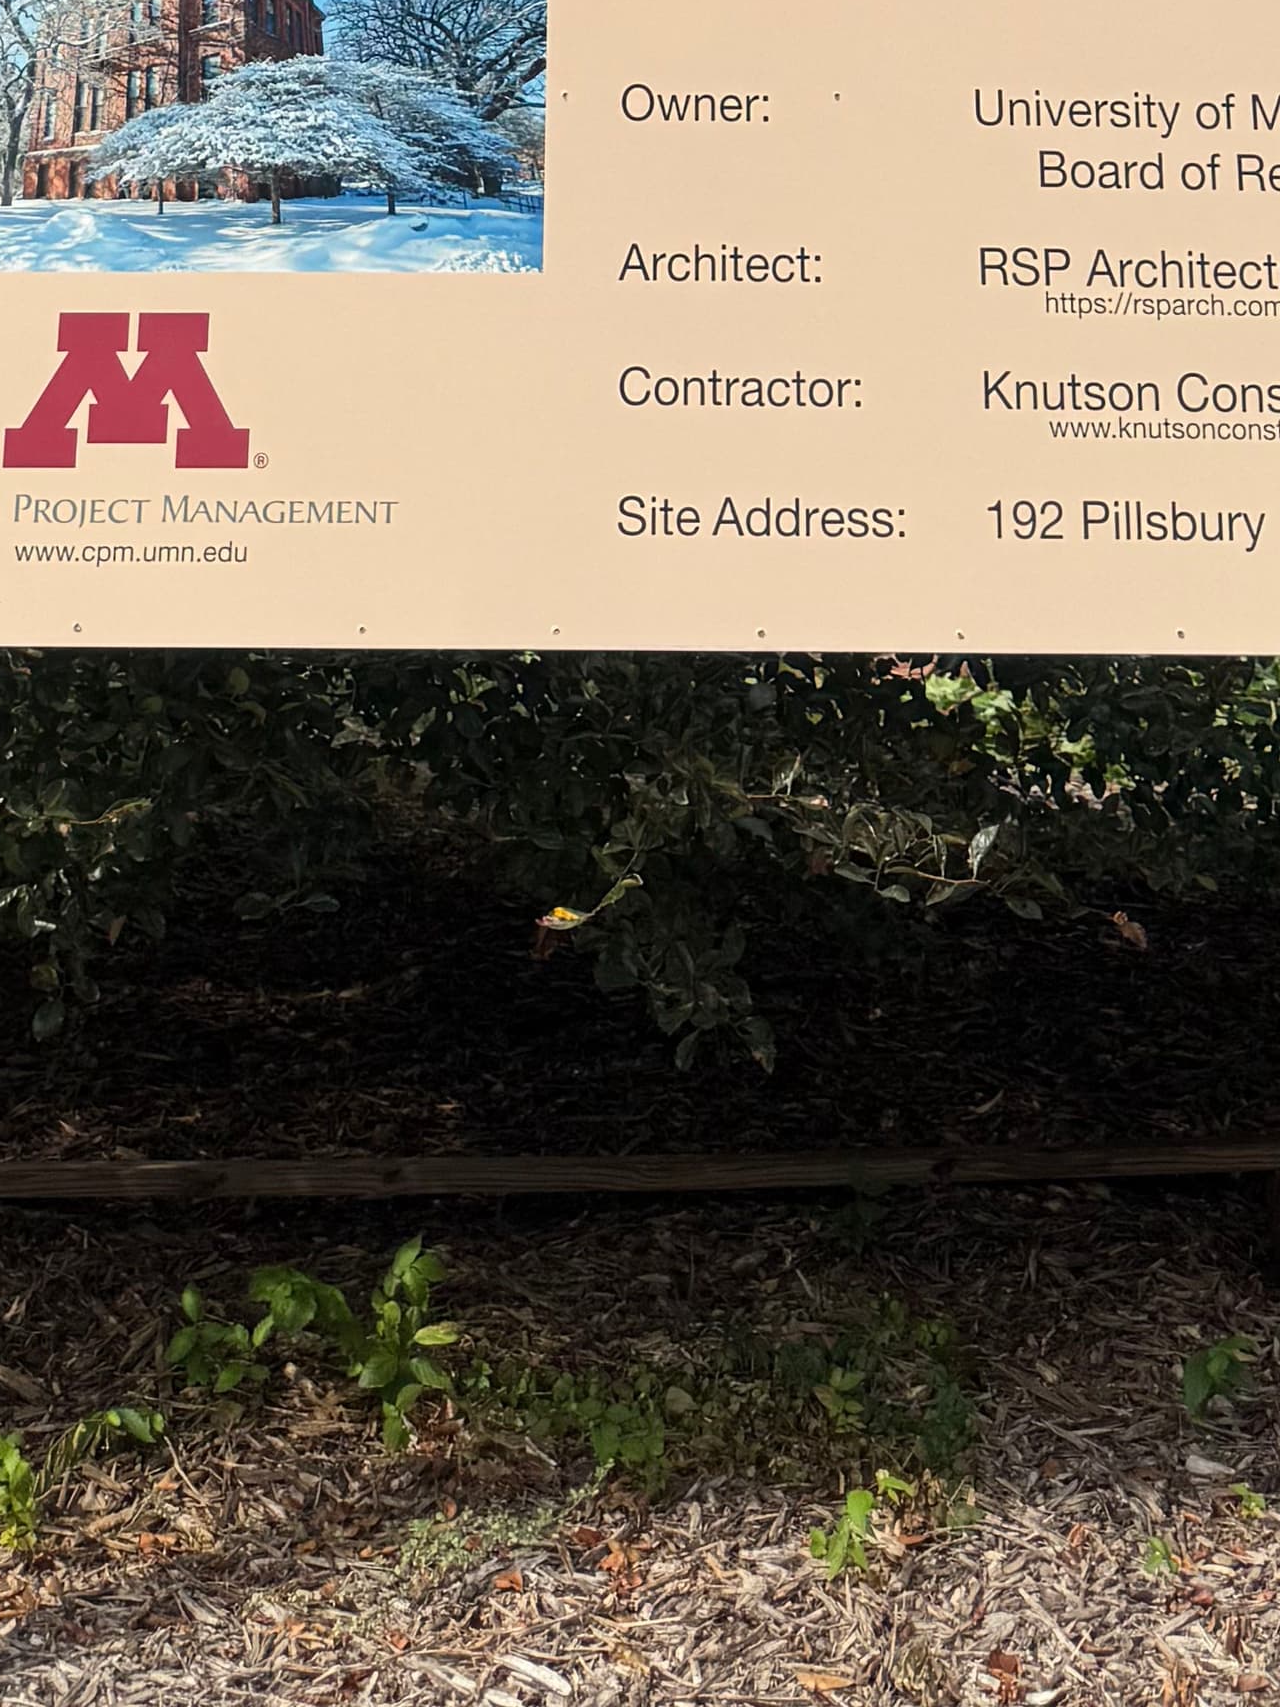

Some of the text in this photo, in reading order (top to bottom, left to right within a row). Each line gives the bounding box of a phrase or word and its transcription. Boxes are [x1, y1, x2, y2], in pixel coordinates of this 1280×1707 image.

[621, 83, 769, 123] Owner:
[974, 88, 1181, 139] University
[1195, 92, 1236, 130] of
[1038, 150, 1165, 190] Board
[1180, 152, 1221, 191] of
[618, 242, 822, 284] Architect:
[979, 246, 1071, 287] RSP
[619, 365, 862, 408] Contractor:
[983, 370, 1160, 412] Knutson
[13, 493, 152, 529] PROJECT
[161, 494, 400, 524] MANAGEMENT
[617, 495, 906, 538] Site Address:
[986, 499, 1064, 540] 192
[1082, 500, 1266, 553] Pillsbury
[14, 540, 248, 568] www.cpm.umn.edu
